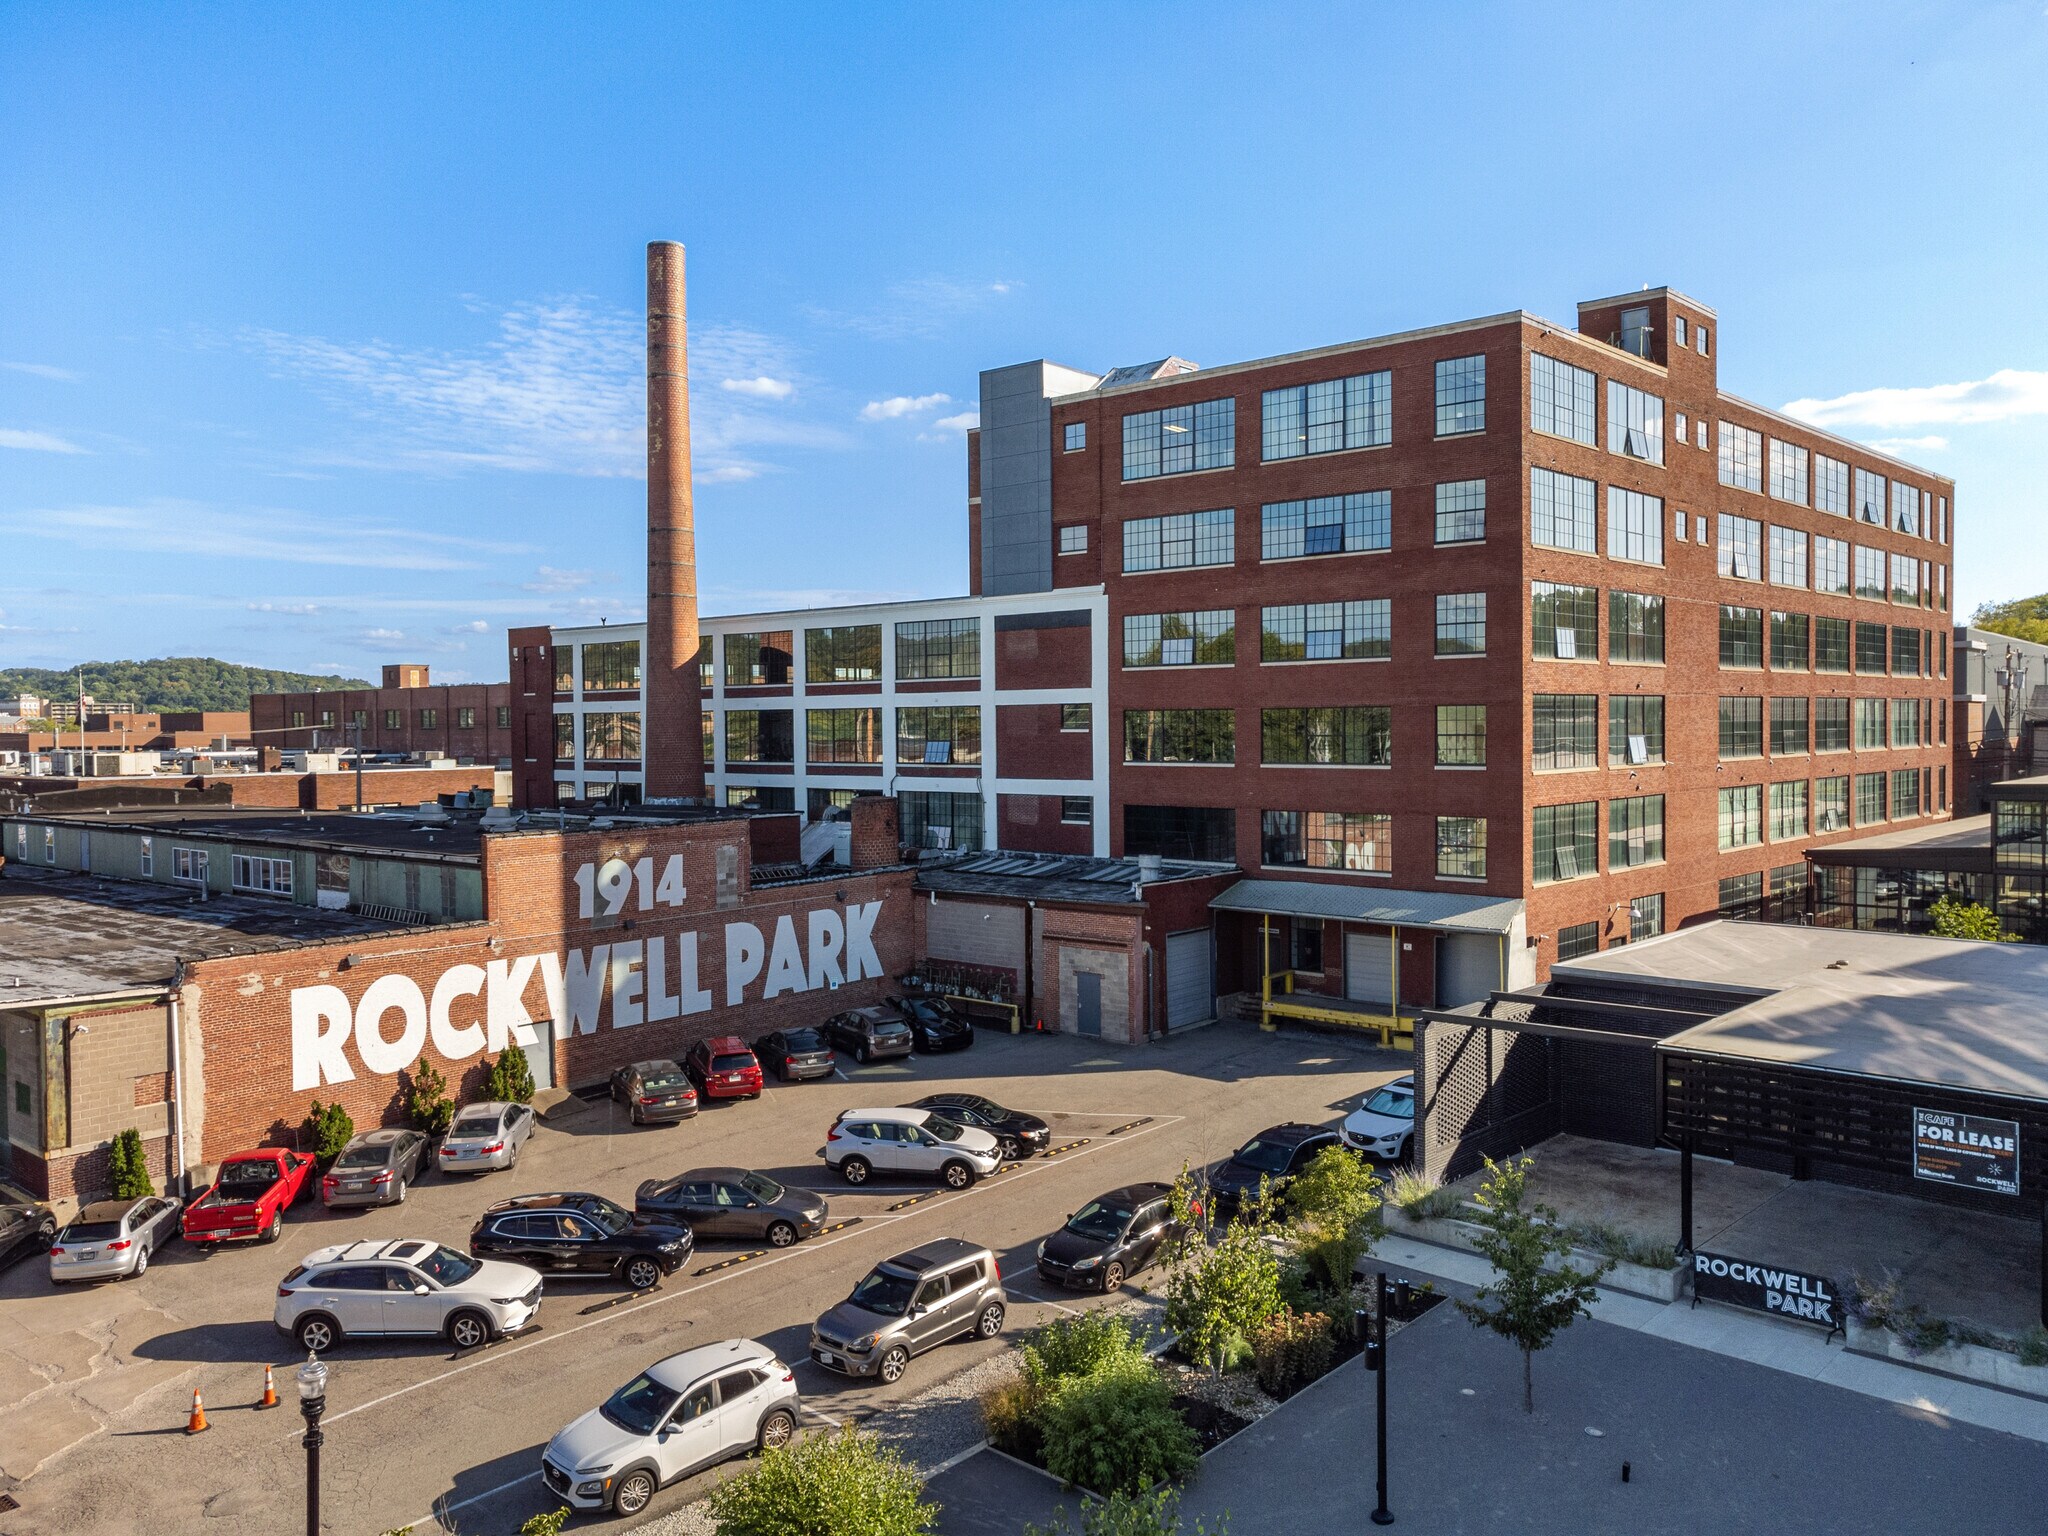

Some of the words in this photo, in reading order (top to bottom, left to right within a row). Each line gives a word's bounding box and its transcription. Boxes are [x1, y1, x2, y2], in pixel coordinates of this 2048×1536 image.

[573, 854, 687, 919] 1914
[290, 931, 713, 1092] ROCKWELL
[725, 900, 885, 1006] PARK
[1924, 1114, 1955, 1127] CAFE
[1918, 1124, 1955, 1142] FOR
[1959, 1130, 2014, 1152] LEASE
[1976, 1175, 2017, 1188] ROCKWELL
[1997, 1185, 2017, 1194] PARK
[1695, 1255, 1832, 1301] ROCKWELL
[1766, 1289, 1833, 1323] PARK
